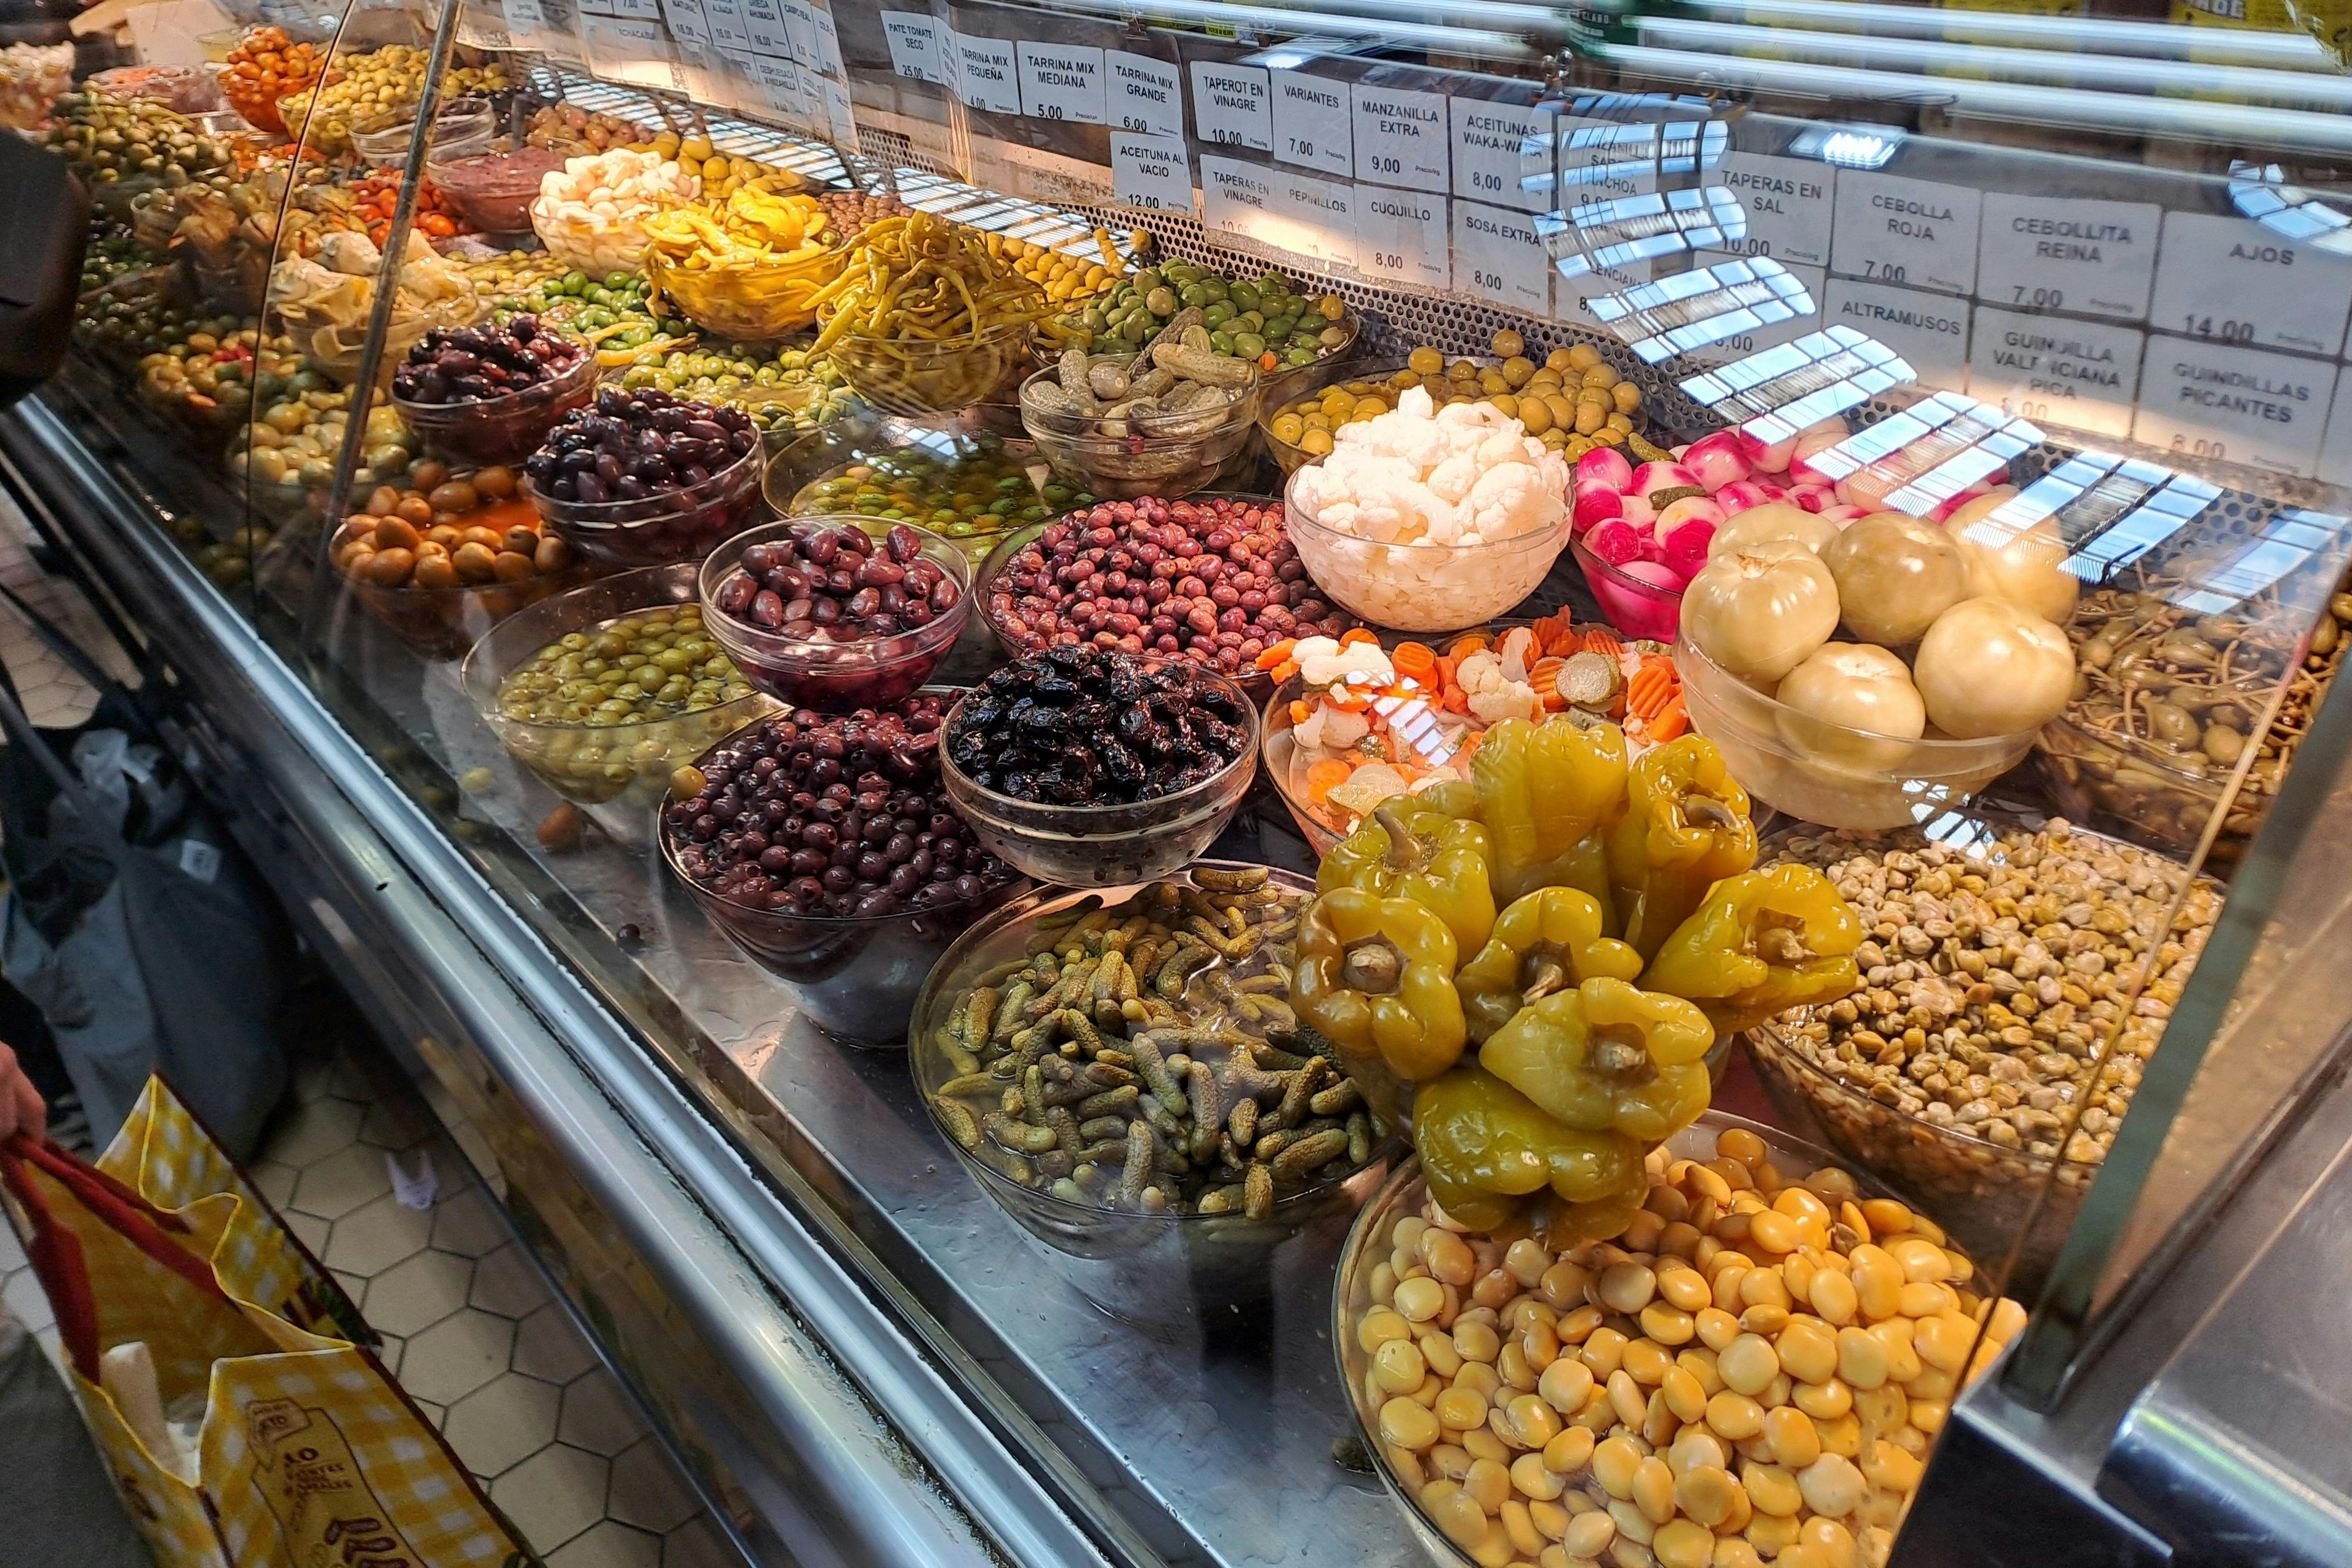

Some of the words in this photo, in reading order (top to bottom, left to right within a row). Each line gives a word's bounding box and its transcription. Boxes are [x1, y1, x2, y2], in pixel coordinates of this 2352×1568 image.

[906, 25, 933, 39] TOMATE
[905, 38, 924, 51] SECO
[961, 47, 991, 65] TARRINA
[992, 55, 1009, 68] MIX
[1027, 55, 1074, 71] TARRINA
[1076, 61, 1095, 75] MIX
[966, 63, 1004, 82] PEQUEÑA
[1037, 71, 1087, 89] MEDIANA
[1115, 65, 1157, 85] TARRINA
[1158, 76, 1174, 91] MIX
[1126, 83, 1167, 103] GRANDE
[1203, 76, 1248, 95] TAPEROT
[1251, 83, 1264, 98] EN
[1284, 84, 1339, 109] VARIANTES
[1213, 93, 1257, 112] VINAGRE
[1362, 100, 1439, 123] MANZANILLA
[1379, 120, 1421, 137] EXTRA
[1466, 115, 1539, 136] ACEITUNAS
[1120, 145, 1171, 163] ACEITUNA
[1172, 154, 1184, 165] AL
[1289, 138, 1314, 156] 7,00
[1138, 162, 1170, 178] VACIO
[1371, 155, 1401, 175] 9,00
[1212, 171, 1256, 191] TAPERAS
[1258, 182, 1270, 196] EN
[1472, 172, 1502, 191] 8,00
[1721, 170, 1795, 195] TAPERAS
[1799, 183, 1822, 199] EN
[1222, 188, 1264, 209] VINAGRE
[1753, 196, 1785, 214] SAL
[1871, 194, 1955, 222] CEBOLLA
[1370, 201, 1431, 222] CUQUILLO
[1466, 216, 1499, 236] SOSA
[1501, 225, 1542, 248] EXTRA
[1887, 218, 1935, 242] ROJA
[2012, 216, 2132, 244] CEBOLLITA
[1375, 252, 1404, 269] 8,00
[2034, 240, 2103, 263] REINA
[2229, 243, 2295, 265] AJOS
[1474, 270, 1502, 291] 8,00
[1841, 300, 1961, 336] ALTRAMUSOS
[2030, 378, 2077, 400] PICA
[2173, 362, 2311, 402] GUINDILLAS
[2179, 386, 2293, 423] PICANTES
